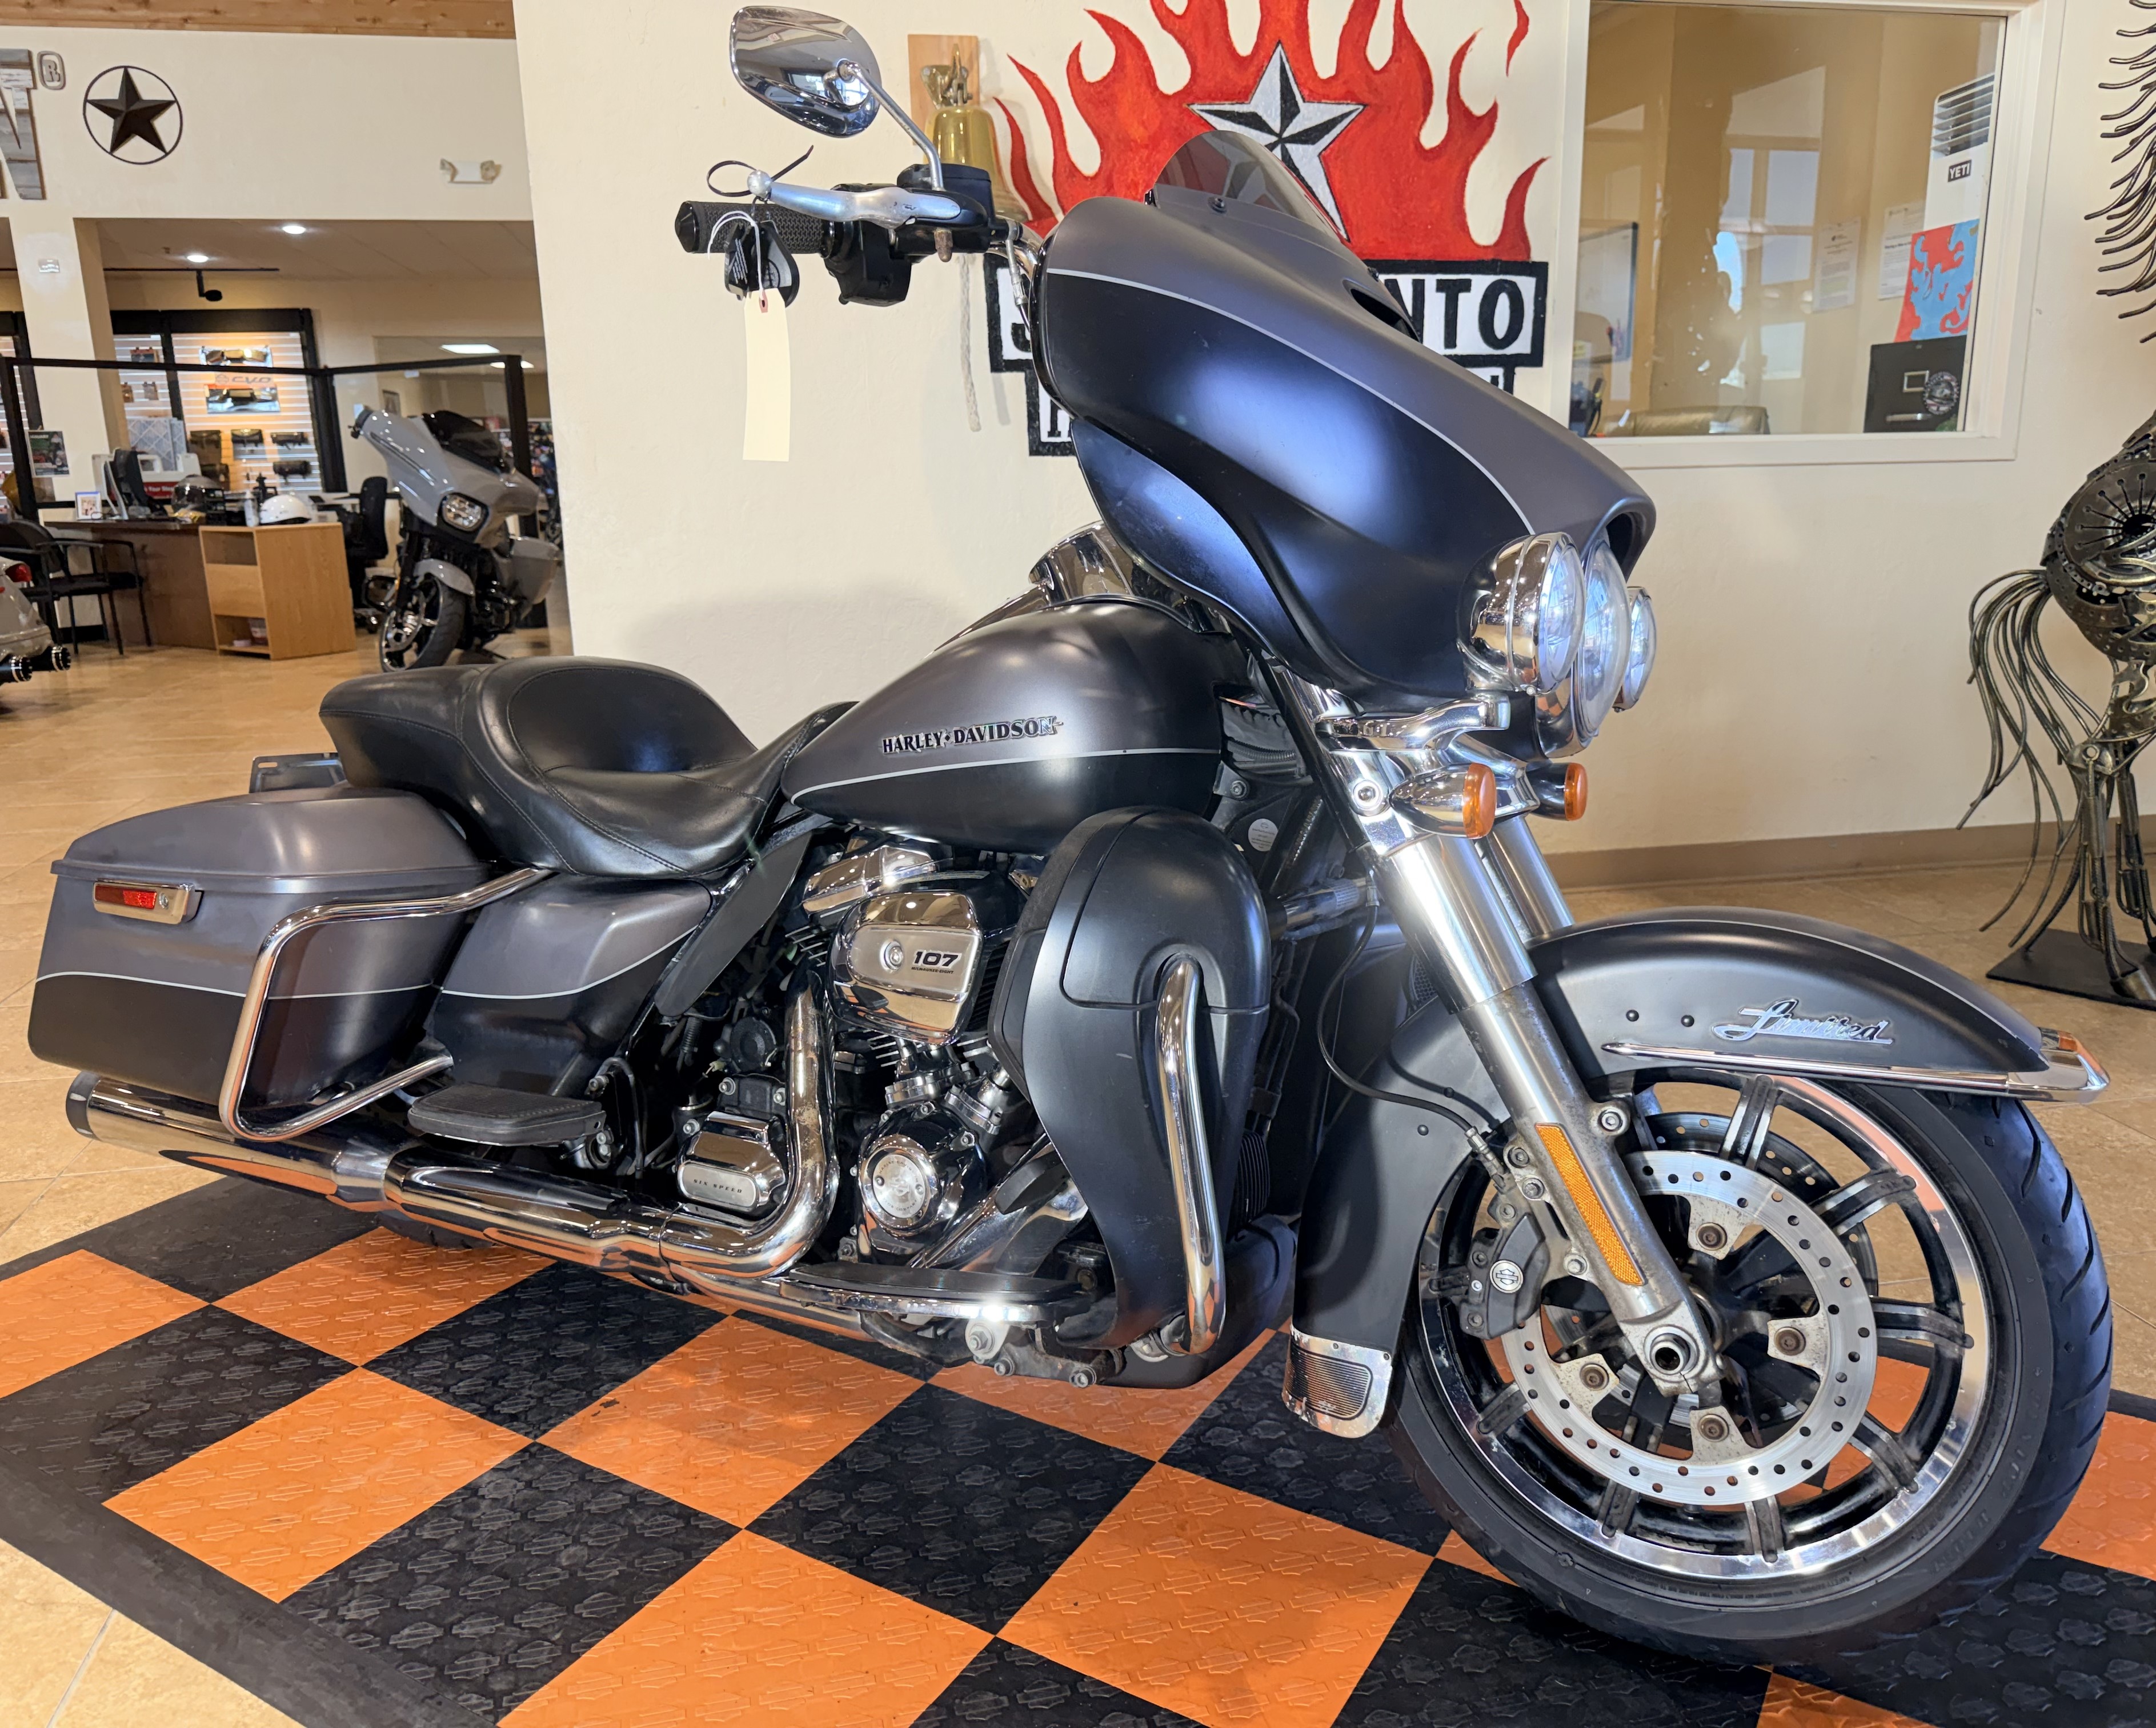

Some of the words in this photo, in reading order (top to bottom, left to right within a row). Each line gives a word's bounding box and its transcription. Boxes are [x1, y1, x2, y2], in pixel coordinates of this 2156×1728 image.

[1950, 163, 1970, 179] YETI
[1384, 278, 1525, 350] NTO
[913, 950, 960, 967] 107
[1712, 998, 1894, 1045] Limited
[713, 1184, 742, 1193] SPEED
